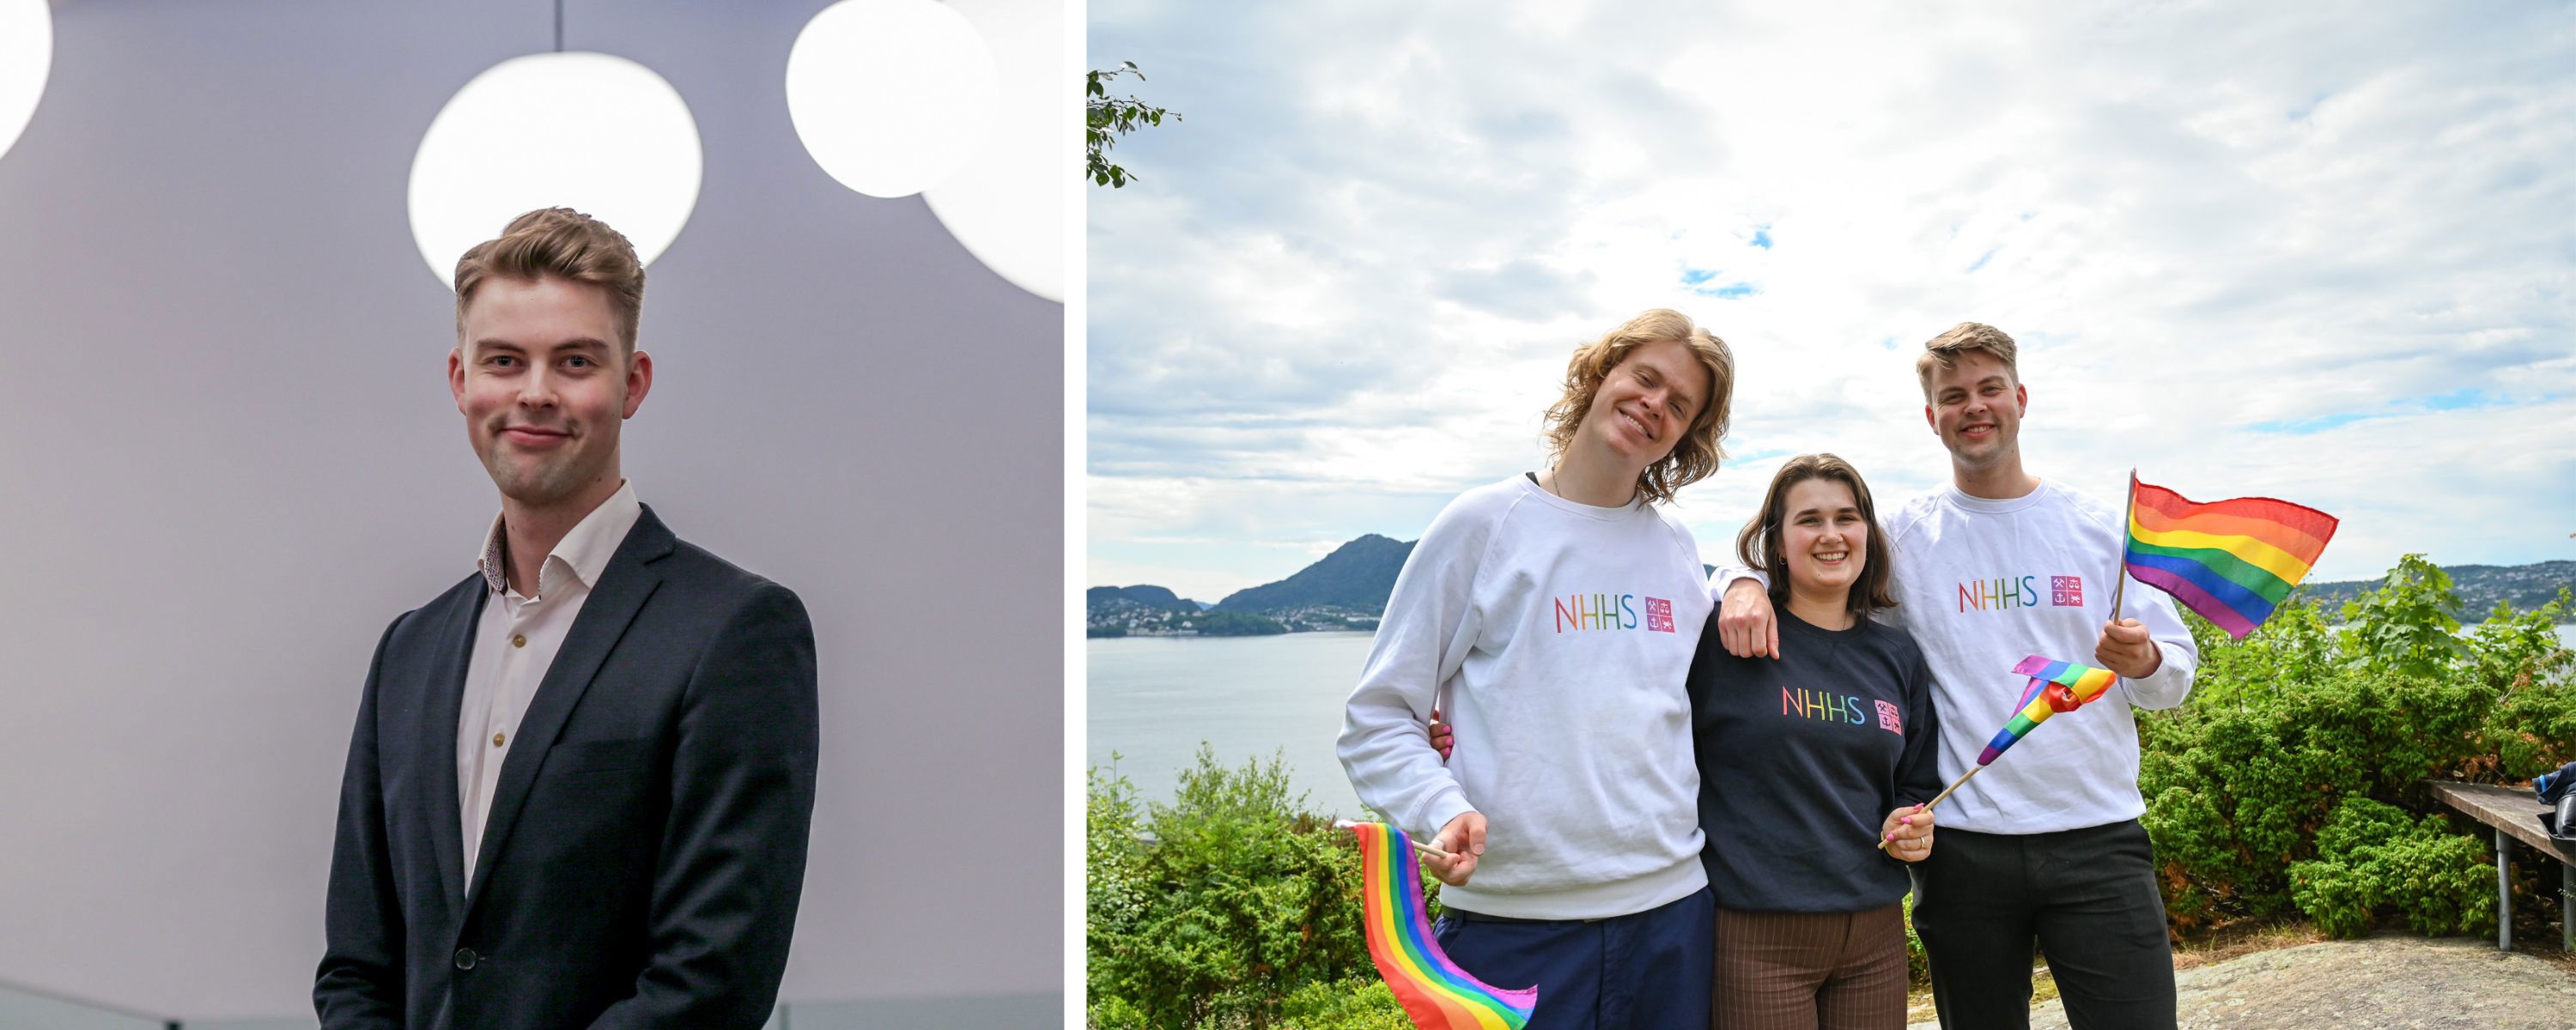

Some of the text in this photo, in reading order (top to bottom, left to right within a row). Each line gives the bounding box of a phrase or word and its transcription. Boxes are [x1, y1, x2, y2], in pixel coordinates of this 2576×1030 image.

[1555, 594, 1637, 633] NHHS
[1959, 576, 2038, 613] NHHS
[1783, 686, 1865, 725] NHHS
